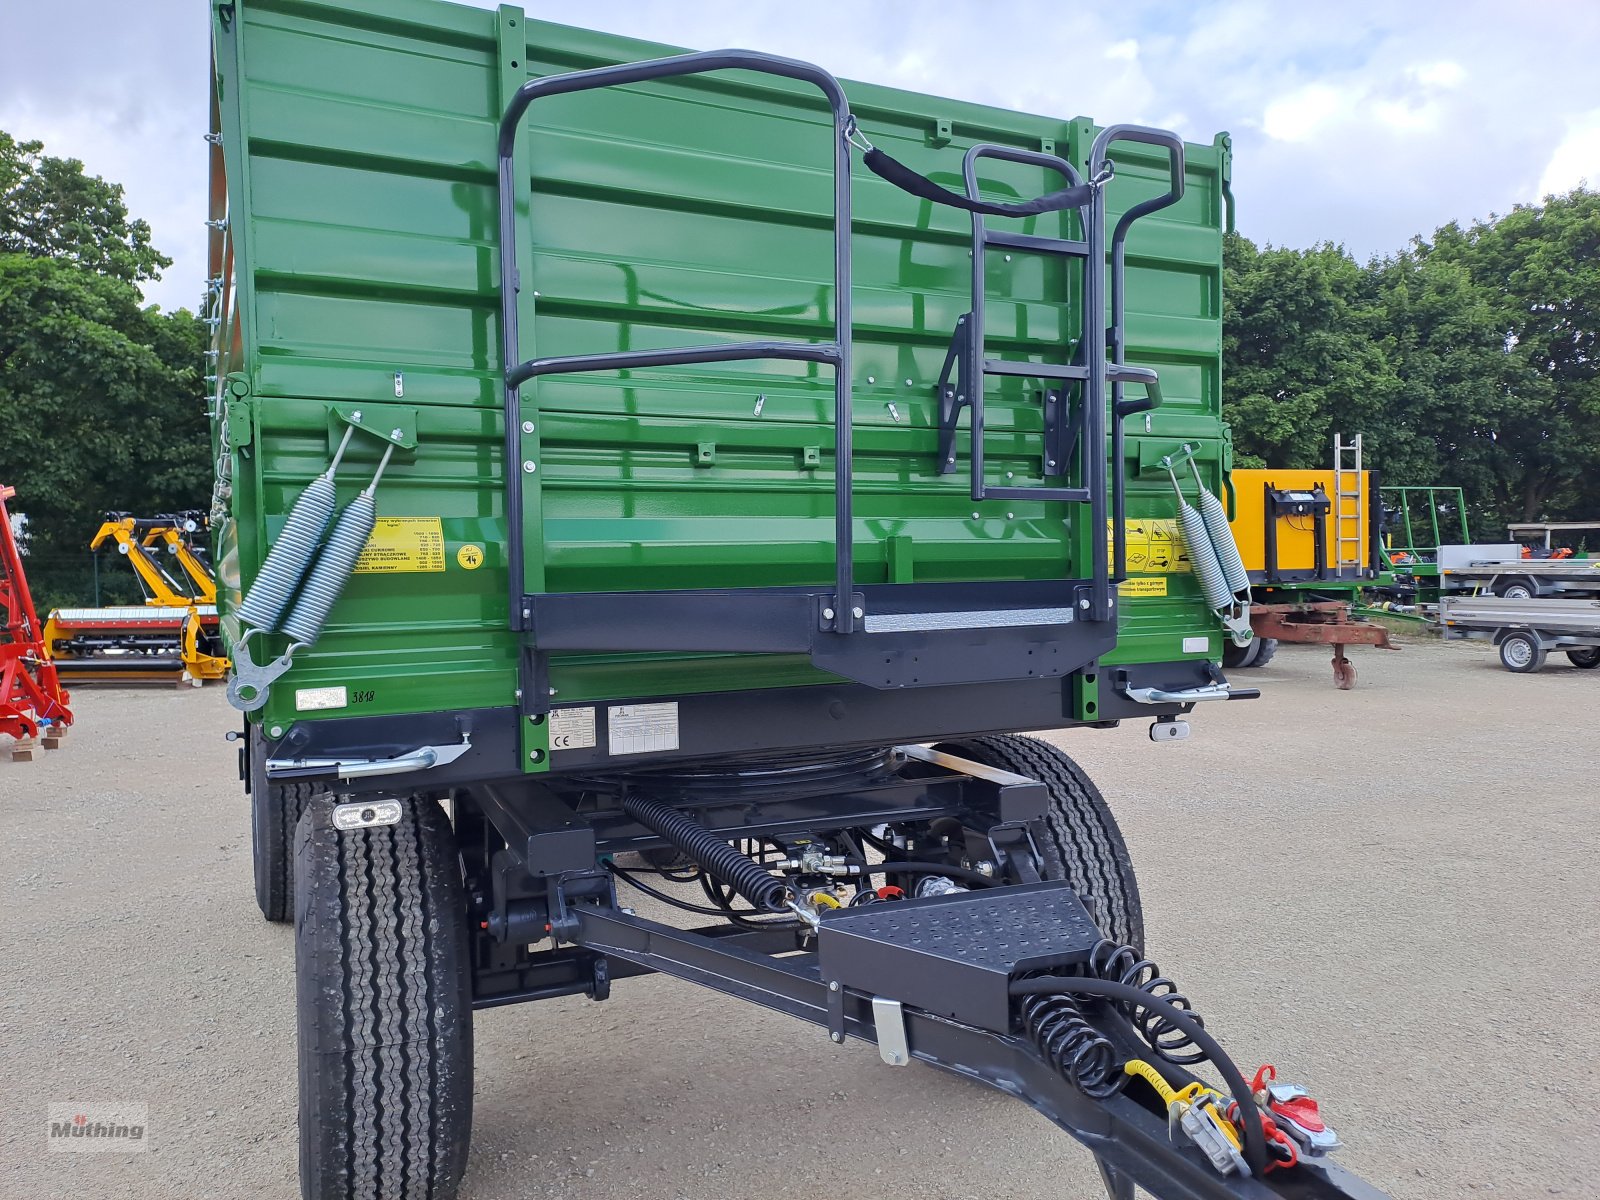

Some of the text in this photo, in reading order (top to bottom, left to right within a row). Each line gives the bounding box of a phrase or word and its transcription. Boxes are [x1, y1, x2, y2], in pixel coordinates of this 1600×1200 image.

[466, 556, 476, 565] 14
[352, 690, 375, 704] 3818
[554, 735, 569, 747] CE
